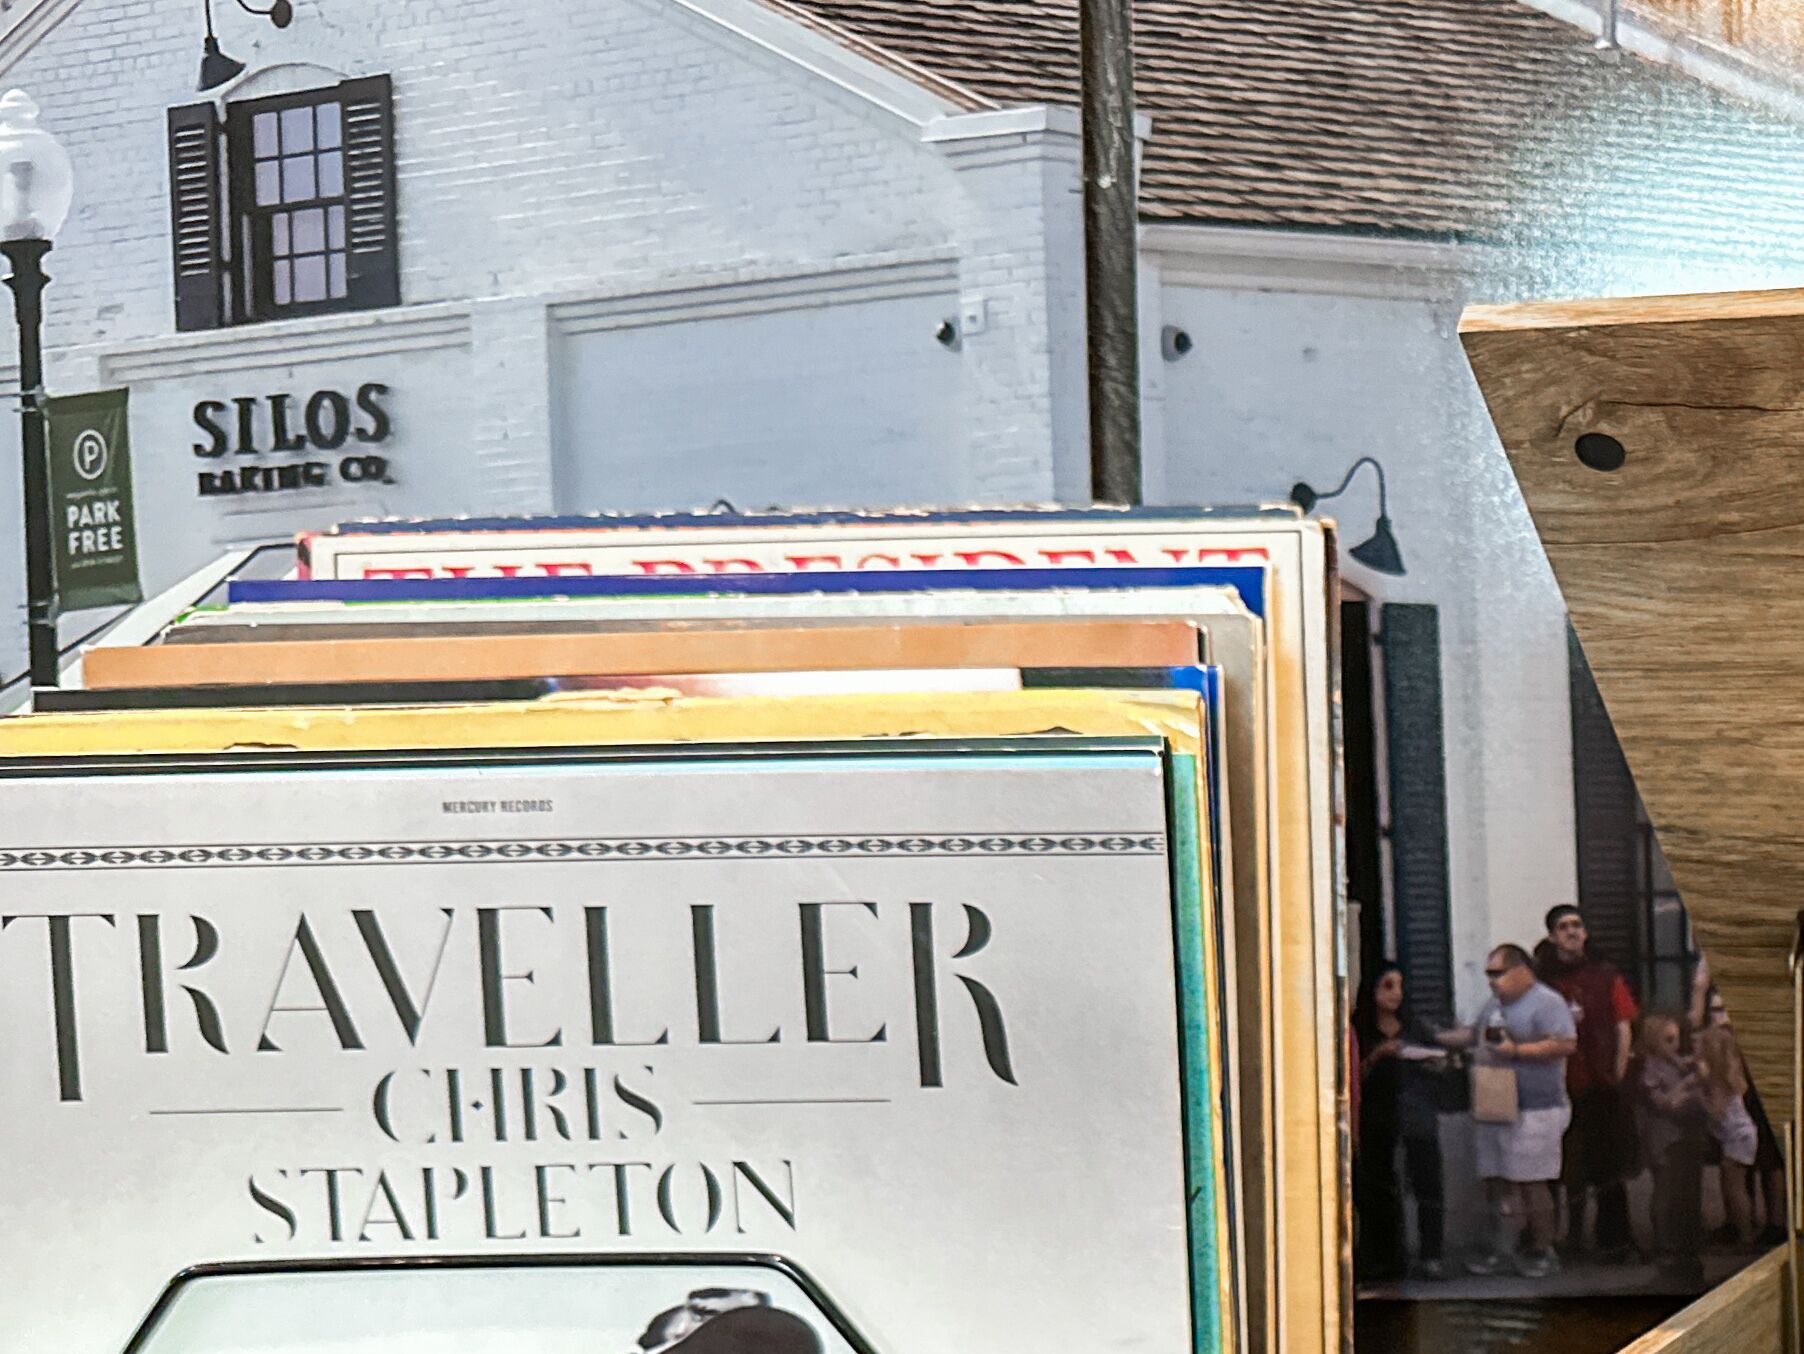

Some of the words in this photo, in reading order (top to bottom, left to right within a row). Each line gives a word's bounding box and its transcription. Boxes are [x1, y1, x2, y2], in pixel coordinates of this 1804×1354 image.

[193, 383, 392, 459] SILOS
[198, 462, 332, 496] BAKING
[339, 456, 396, 485] CO.
[67, 501, 121, 528] PARK
[68, 526, 124, 555] FREE
[442, 801, 497, 813] MERCURY
[500, 800, 553, 812] RECORDS
[2, 902, 1019, 1102] TRAVELLER
[373, 1065, 663, 1144] CHRIS
[248, 1159, 798, 1245] STAPLETON
